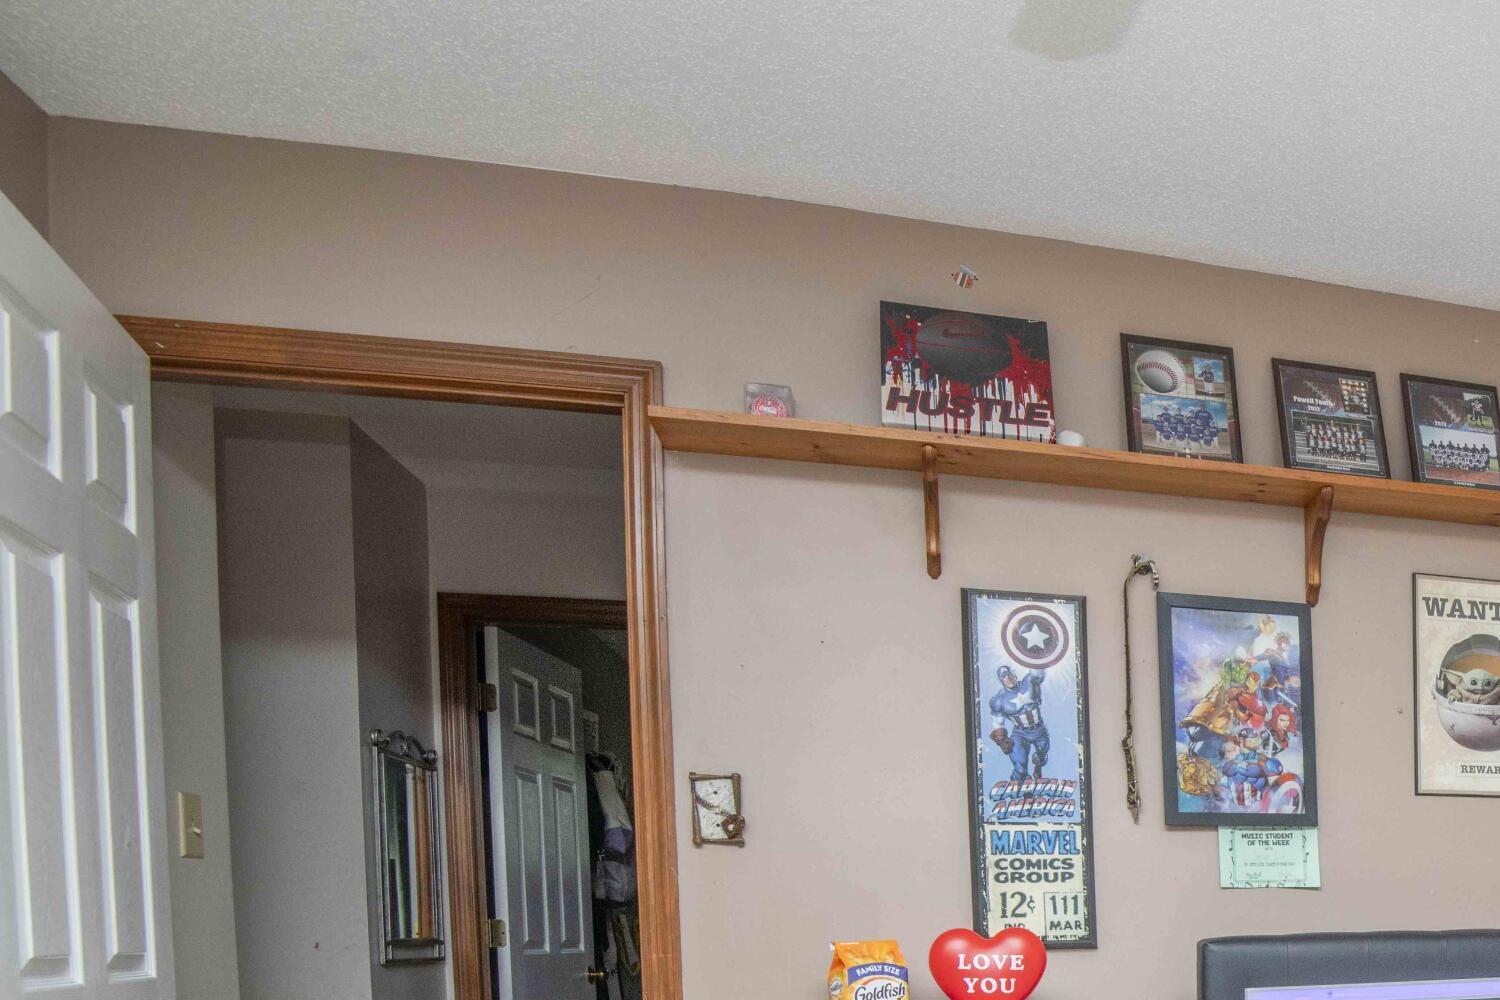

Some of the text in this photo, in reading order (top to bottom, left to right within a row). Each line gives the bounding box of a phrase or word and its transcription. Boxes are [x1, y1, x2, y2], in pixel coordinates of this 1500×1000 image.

[886, 387, 1050, 427] HUSTLE
[989, 778, 1077, 801] CAPTAIN
[989, 799, 1076, 820] AMERICA
[991, 829, 1080, 856] MARVEL
[993, 858, 1075, 871] COMICS
[993, 871, 1075, 884] GROUP
[1049, 895, 1079, 916] 111
[1049, 920, 1083, 931] MAR
[856, 965, 901, 977] FAMILY SIZE
[957, 954, 1025, 971] LOVE
[963, 978, 1017, 993] YOU
